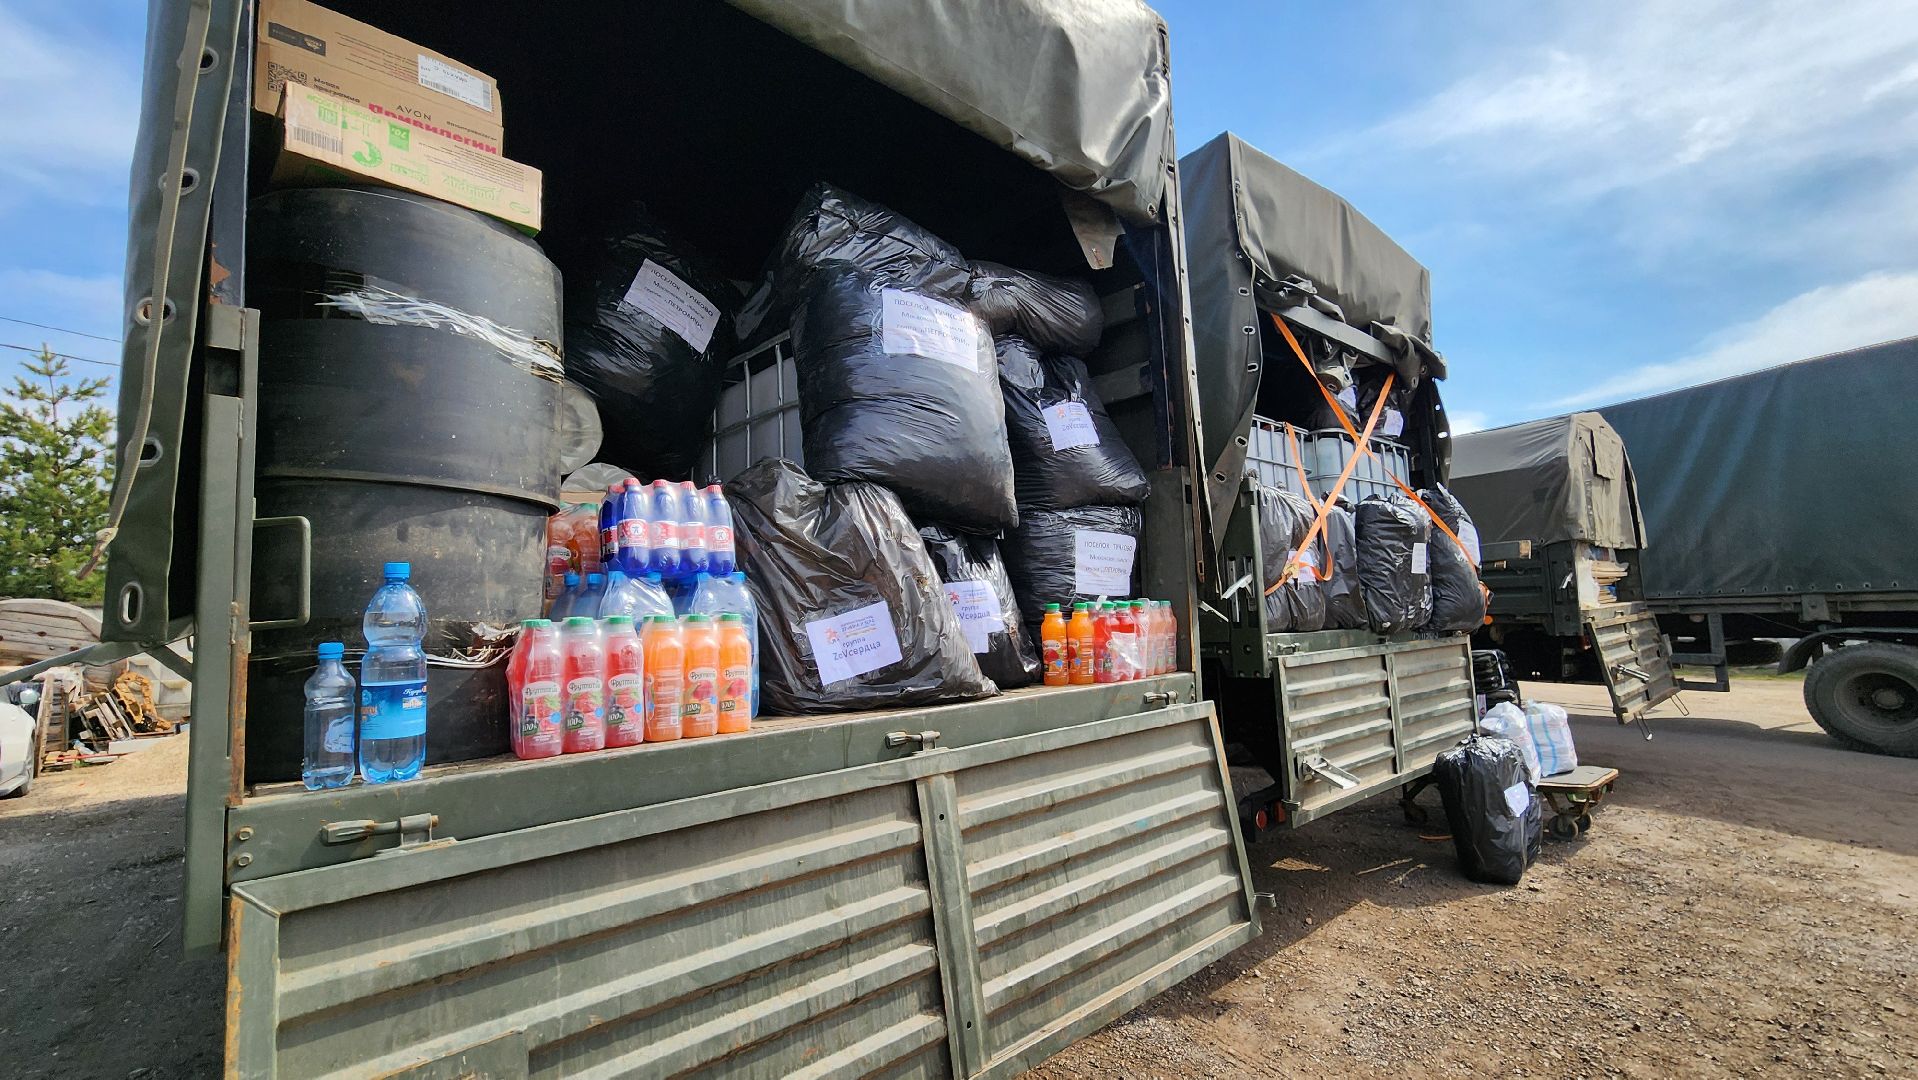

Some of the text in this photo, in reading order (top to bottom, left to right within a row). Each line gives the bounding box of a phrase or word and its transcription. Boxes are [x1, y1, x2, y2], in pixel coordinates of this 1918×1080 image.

[397, 104, 432, 121] AVON
[685, 290, 714, 317] ТУЧКОВО
[842, 637, 866, 648] группа
